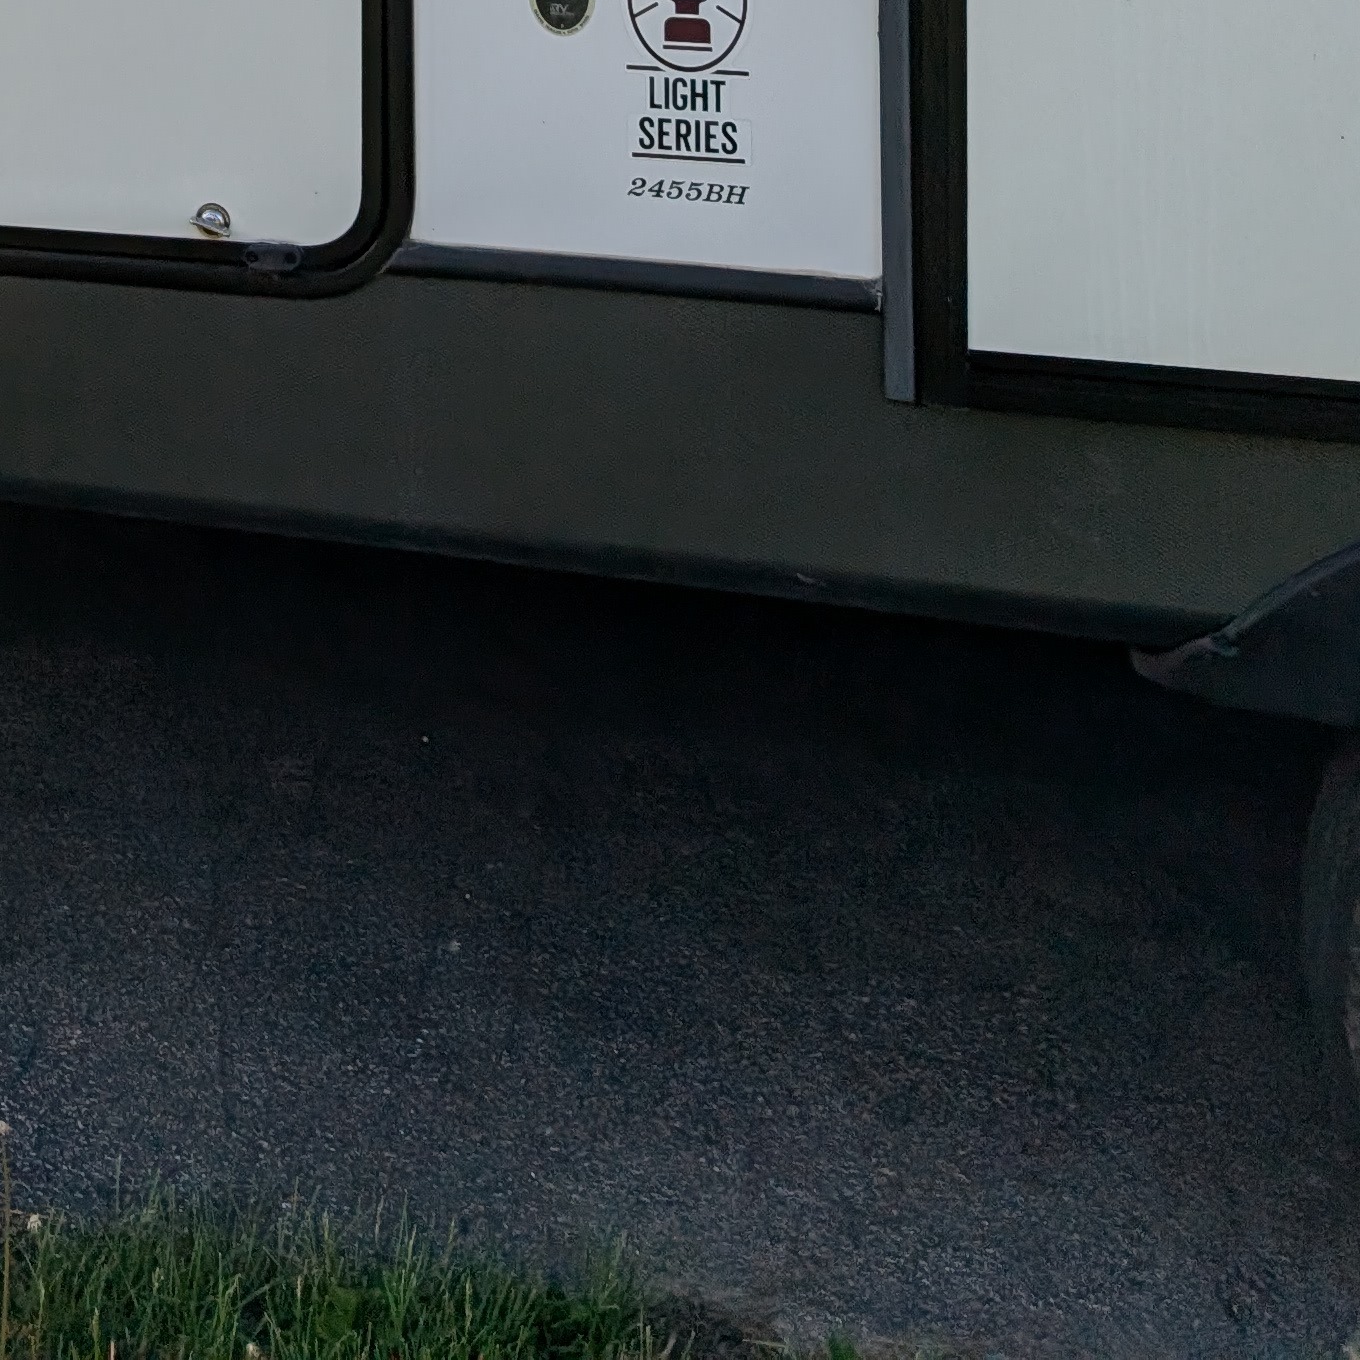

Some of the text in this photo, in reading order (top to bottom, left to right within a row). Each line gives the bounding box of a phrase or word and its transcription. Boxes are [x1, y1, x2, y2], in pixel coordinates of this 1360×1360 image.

[649, 76, 726, 113] LIGHT
[638, 116, 738, 155] SERIES
[627, 176, 750, 205] 2455BH
